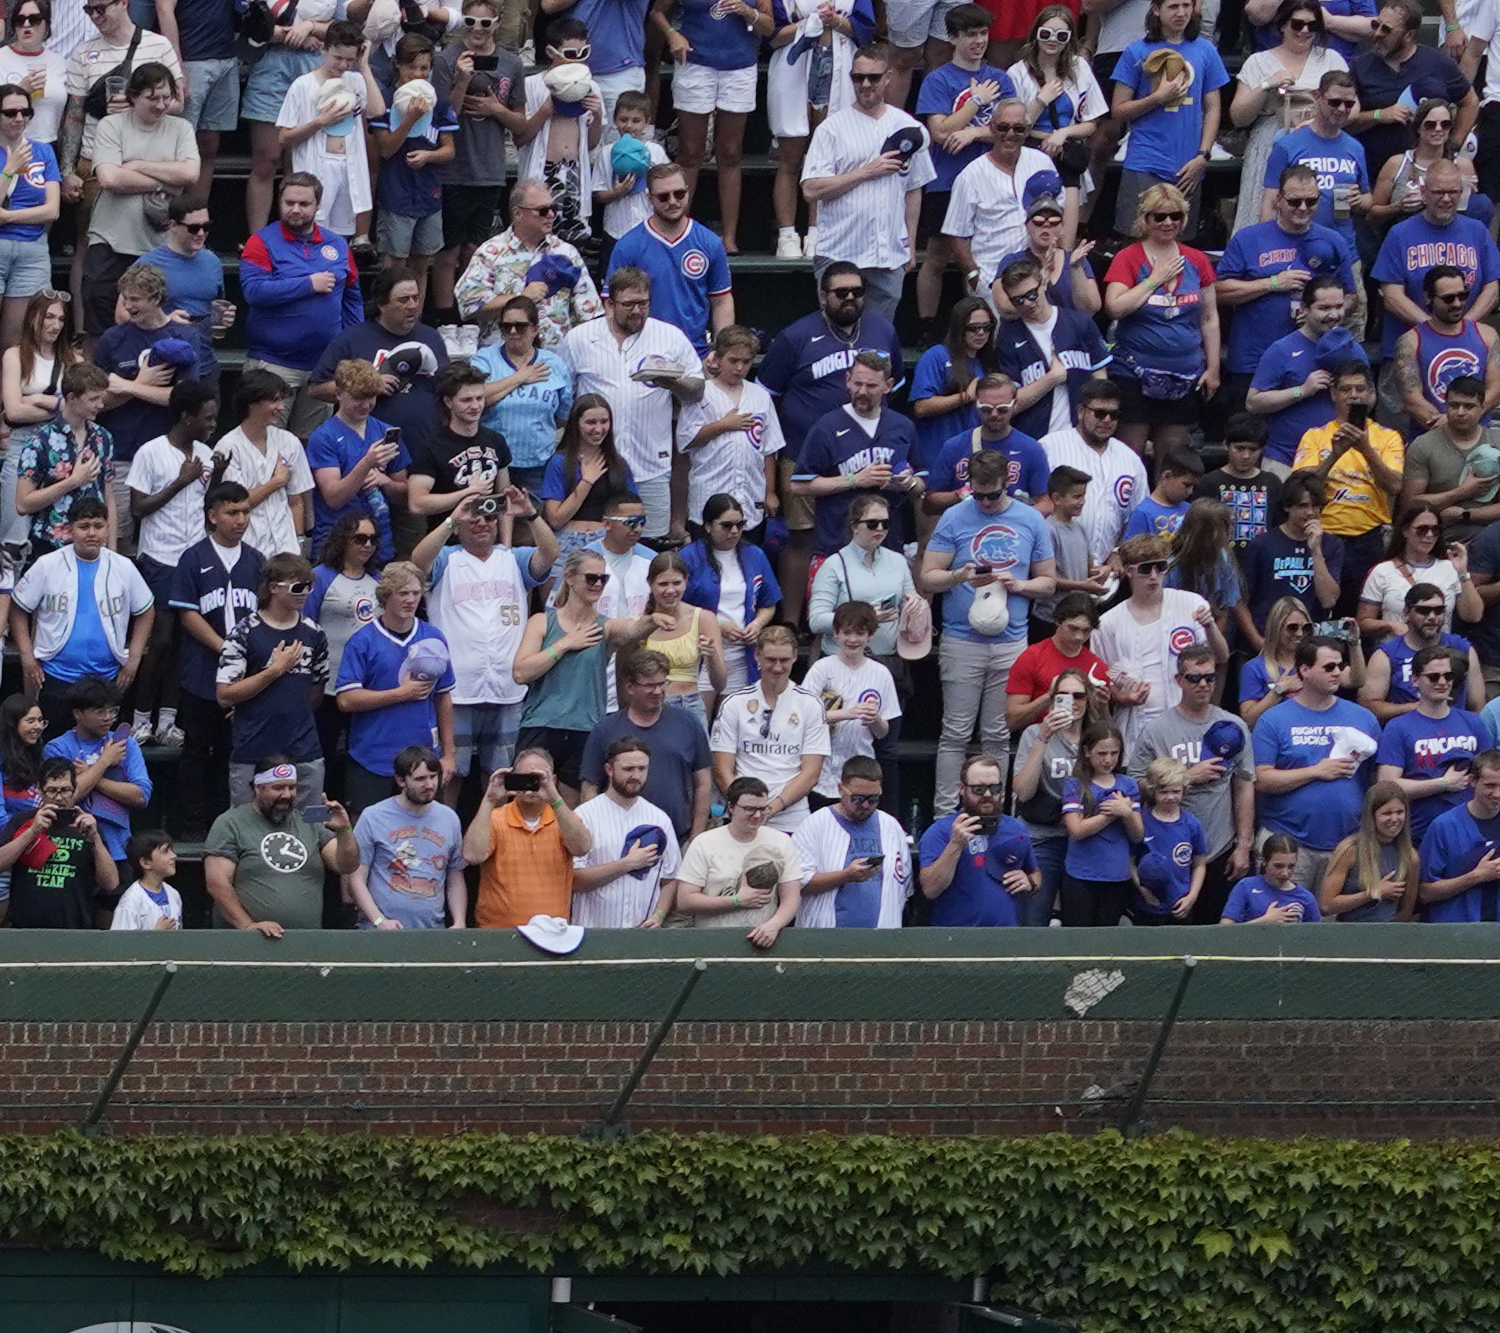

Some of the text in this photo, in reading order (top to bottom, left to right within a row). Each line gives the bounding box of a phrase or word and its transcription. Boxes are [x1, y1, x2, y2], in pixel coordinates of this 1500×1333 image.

[1298, 158, 1358, 175] FRIDAY
[1405, 243, 1479, 271] CHICAGO
[448, 446, 499, 467] USA
[499, 605, 520, 626] 56
[1291, 726, 1319, 736] RIGHT
[742, 740, 802, 756] Emirates
[1291, 735, 1331, 746] SUCKS.
[1413, 735, 1478, 757] CHICAGO
[35, 874, 66, 890] TEAM
